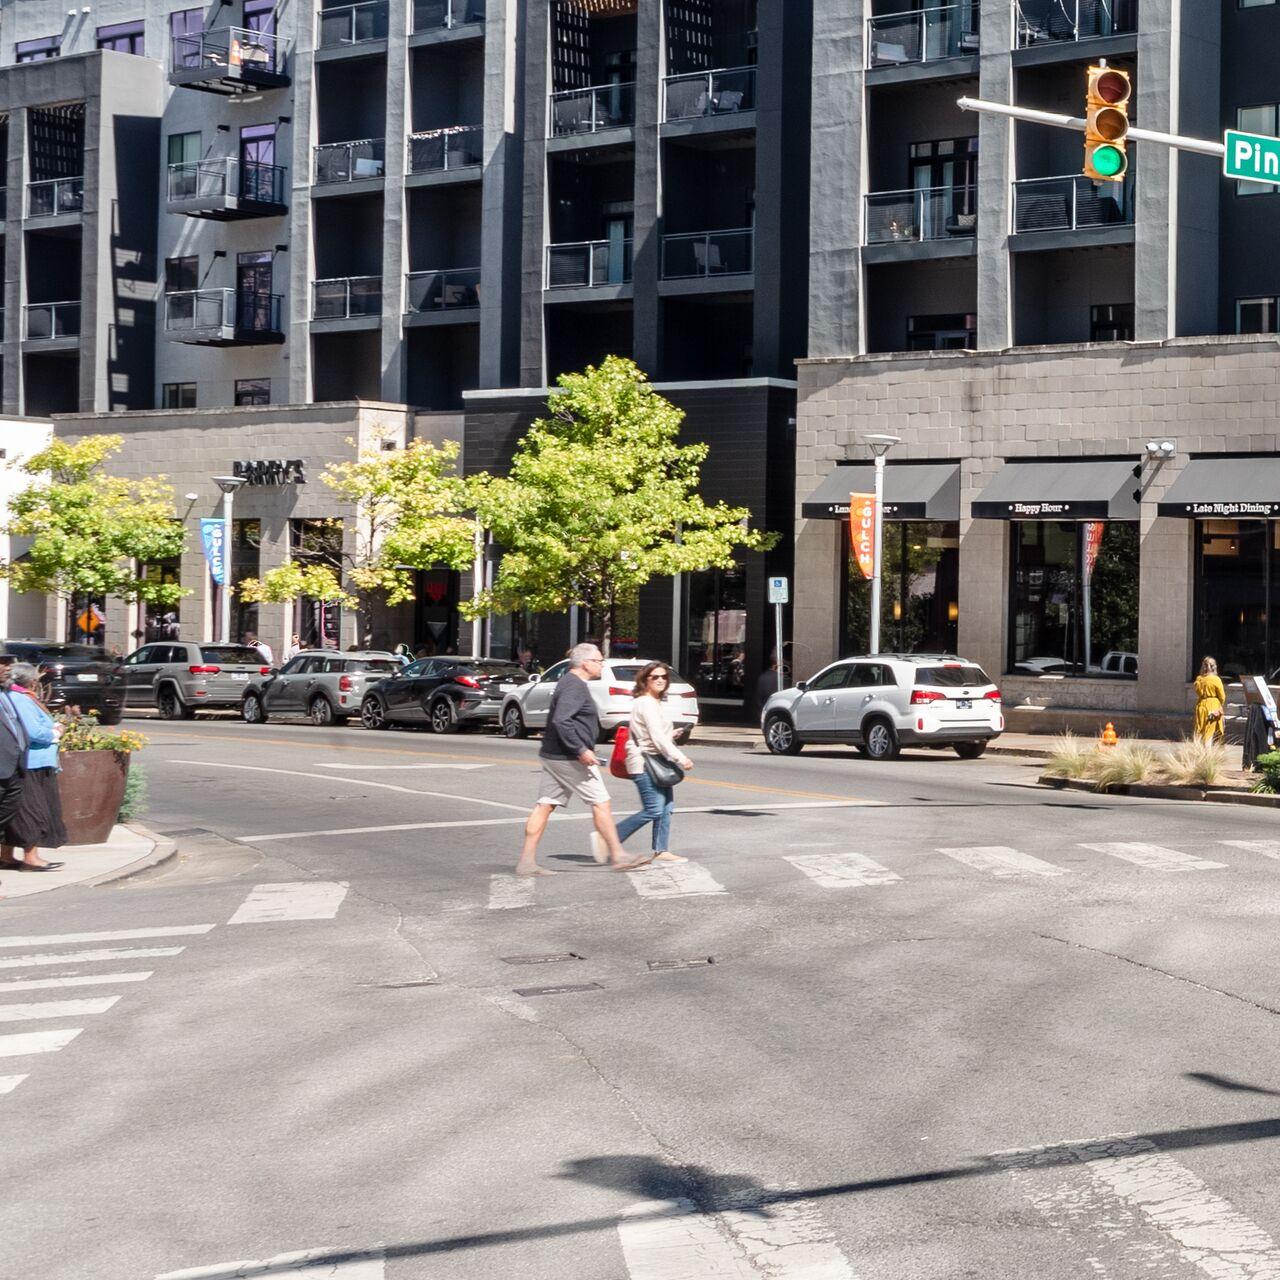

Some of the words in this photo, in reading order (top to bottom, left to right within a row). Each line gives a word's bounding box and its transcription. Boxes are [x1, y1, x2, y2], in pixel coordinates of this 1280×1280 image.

[1015, 503, 1040, 514] Happy
[1041, 503, 1063, 512] Hour
[1193, 503, 1213, 513] Late
[1213, 503, 1240, 514] Night
[1240, 503, 1272, 514] Dining
[859, 506, 872, 564] GULCH
